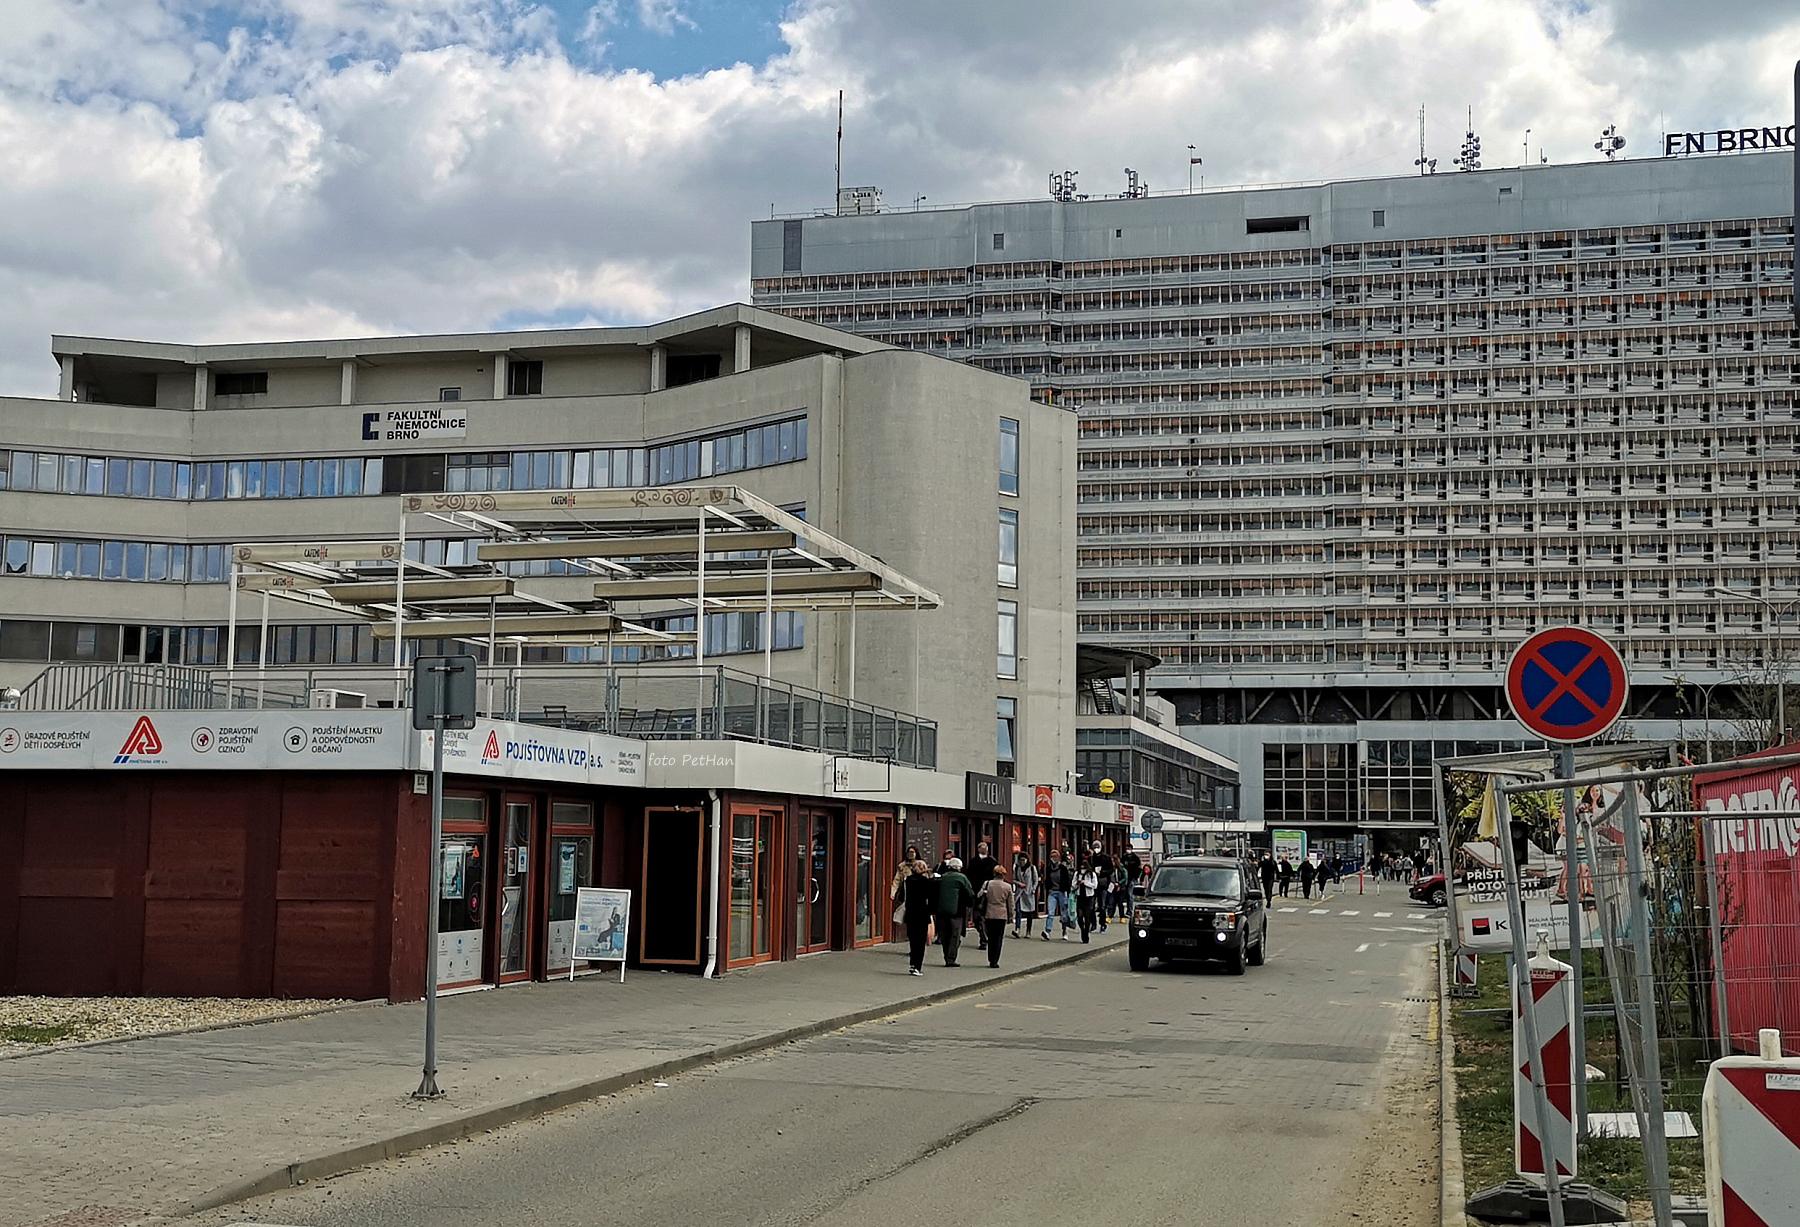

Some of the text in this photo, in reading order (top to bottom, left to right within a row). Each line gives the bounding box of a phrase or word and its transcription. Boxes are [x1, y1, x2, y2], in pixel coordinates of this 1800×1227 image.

[1666, 132, 1705, 155] FN
[387, 408, 442, 421] FAKULTNÍ
[395, 418, 466, 430] NEMOCNICE
[386, 430, 420, 440] BRNO
[218, 726, 259, 735] ZDRAVOTNÍ
[349, 727, 383, 735] MAJETKU
[312, 736, 318, 744] A
[506, 739, 565, 764] POJIŠŤOVNA
